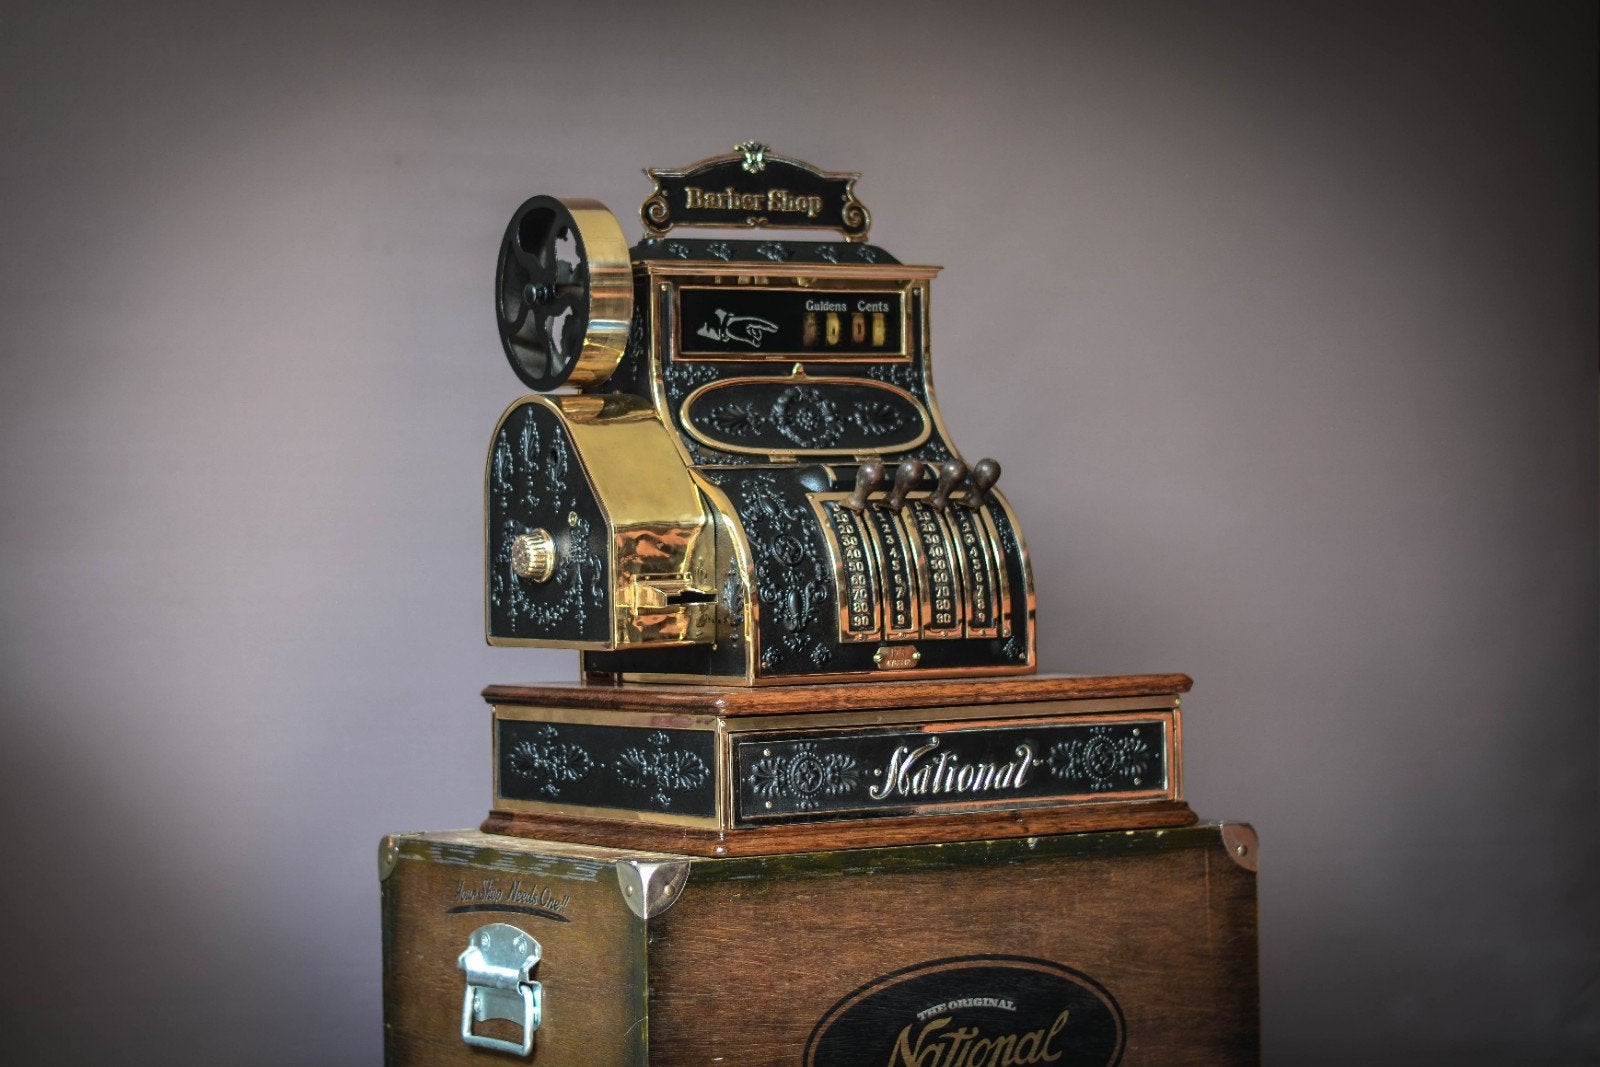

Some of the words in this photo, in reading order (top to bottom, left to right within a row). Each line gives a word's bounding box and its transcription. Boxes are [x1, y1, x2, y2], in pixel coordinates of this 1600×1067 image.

[685, 187, 766, 211] Barber
[767, 189, 823, 218] Shop
[805, 299, 848, 312] Guldens
[857, 300, 889, 312] Cents
[833, 512, 849, 523] 10
[876, 512, 886, 521] 1
[916, 511, 931, 521] 10
[838, 524, 854, 534] 20
[881, 523, 891, 532] 2
[921, 522, 936, 531] 20
[842, 535, 858, 546] 30
[885, 534, 895, 544] 3
[924, 534, 940, 544] 30
[846, 546, 862, 559] 40
[890, 547, 898, 558] 4
[928, 546, 943, 557] 40
[970, 546, 978, 558] 4
[848, 560, 864, 571] 50
[892, 560, 901, 571] 5
[930, 559, 946, 570] 50
[972, 559, 981, 570] 5
[850, 574, 866, 586] 60
[894, 573, 902, 585] 6
[933, 571, 949, 583] 60
[975, 572, 983, 583] 6
[852, 588, 868, 600] 70
[895, 586, 903, 599] 7
[935, 585, 950, 598] 70
[976, 584, 984, 597] 7
[853, 601, 869, 613] 80
[896, 600, 905, 611] 8
[935, 599, 951, 610] 80
[976, 599, 986, 610] 8
[853, 615, 870, 627] 90
[897, 614, 905, 626] 9
[978, 612, 986, 623] 9
[869, 736, 1031, 800] National
[480, 879, 504, 903] Shop
[506, 879, 539, 906] Needs
[916, 1003, 948, 1021] THE
[947, 997, 1017, 1012] ORIGINAL
[887, 1009, 1071, 1067] National
